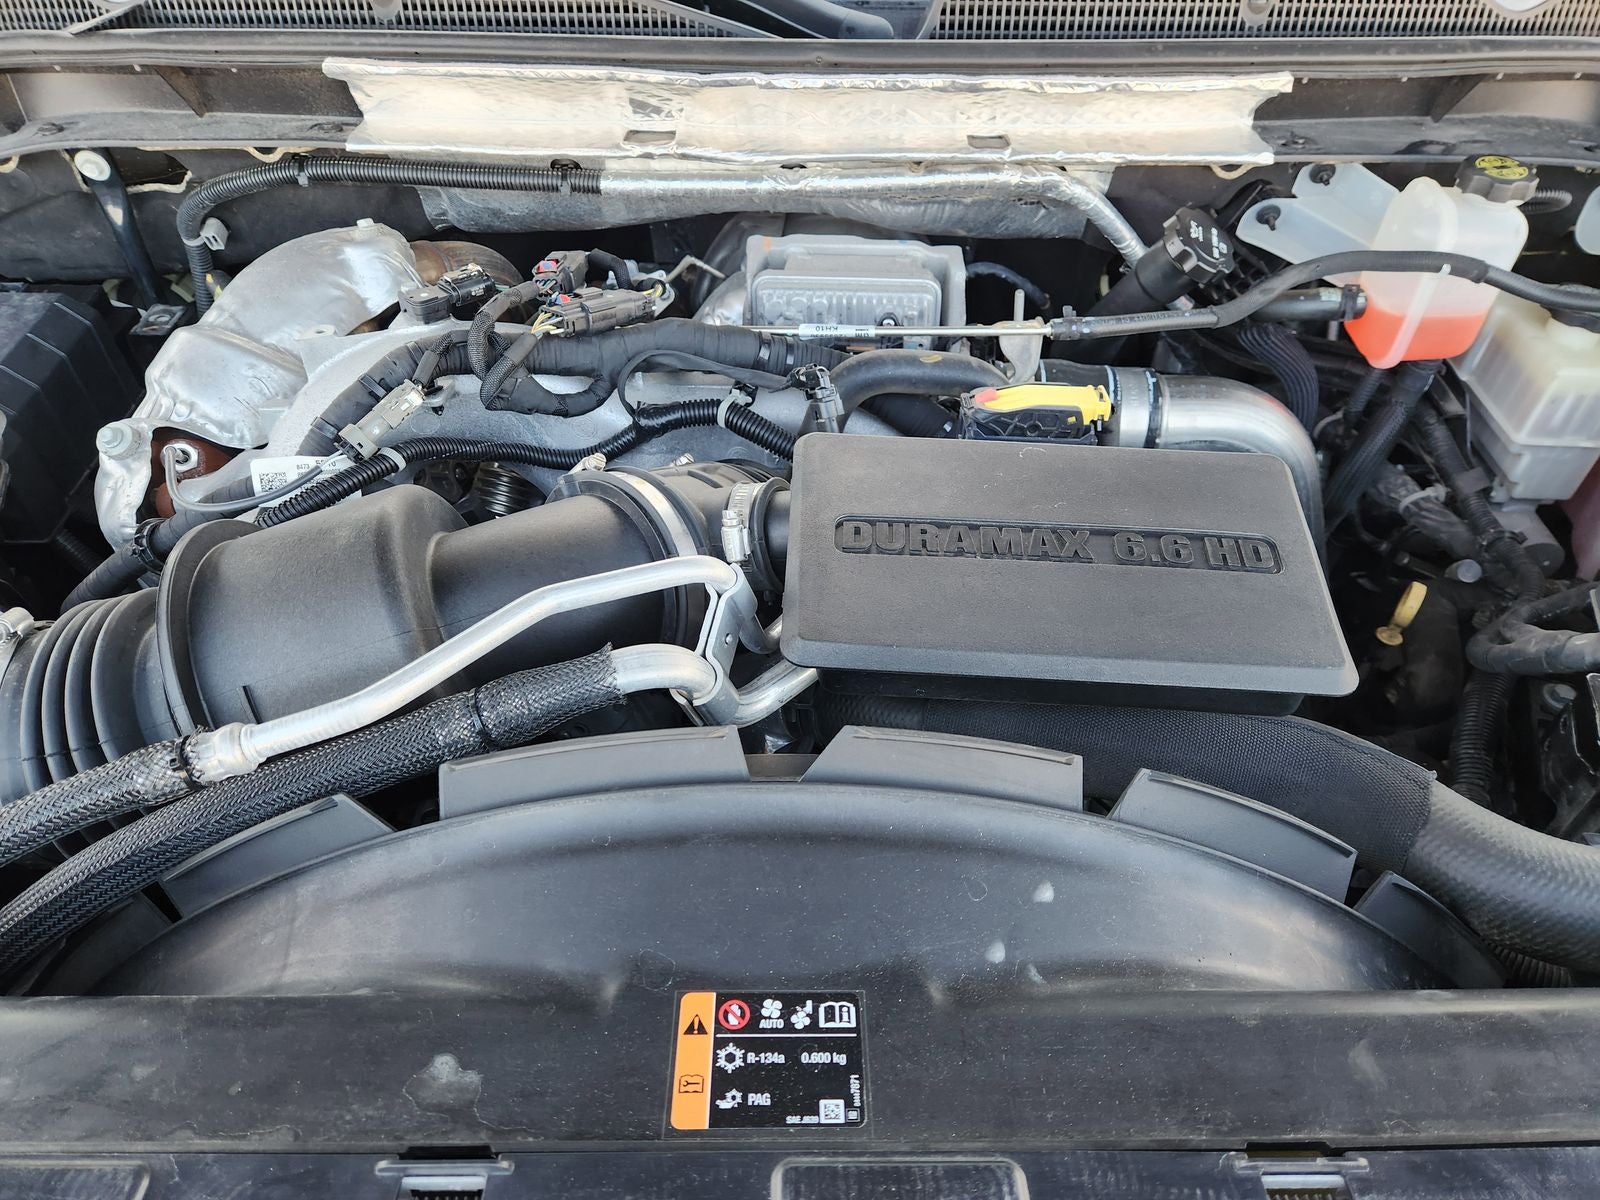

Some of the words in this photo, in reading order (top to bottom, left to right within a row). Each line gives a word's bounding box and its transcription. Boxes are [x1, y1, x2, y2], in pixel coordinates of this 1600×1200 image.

[841, 520, 1095, 562] DURAMAX
[1113, 532, 1195, 566] 6.6
[1203, 536, 1277, 570] HD
[759, 1018, 784, 1029] AUTO
[746, 1052, 785, 1064] R-134a
[800, 1052, 832, 1064] 0.600
[833, 1052, 847, 1066] kg
[747, 1093, 771, 1106] PAG
